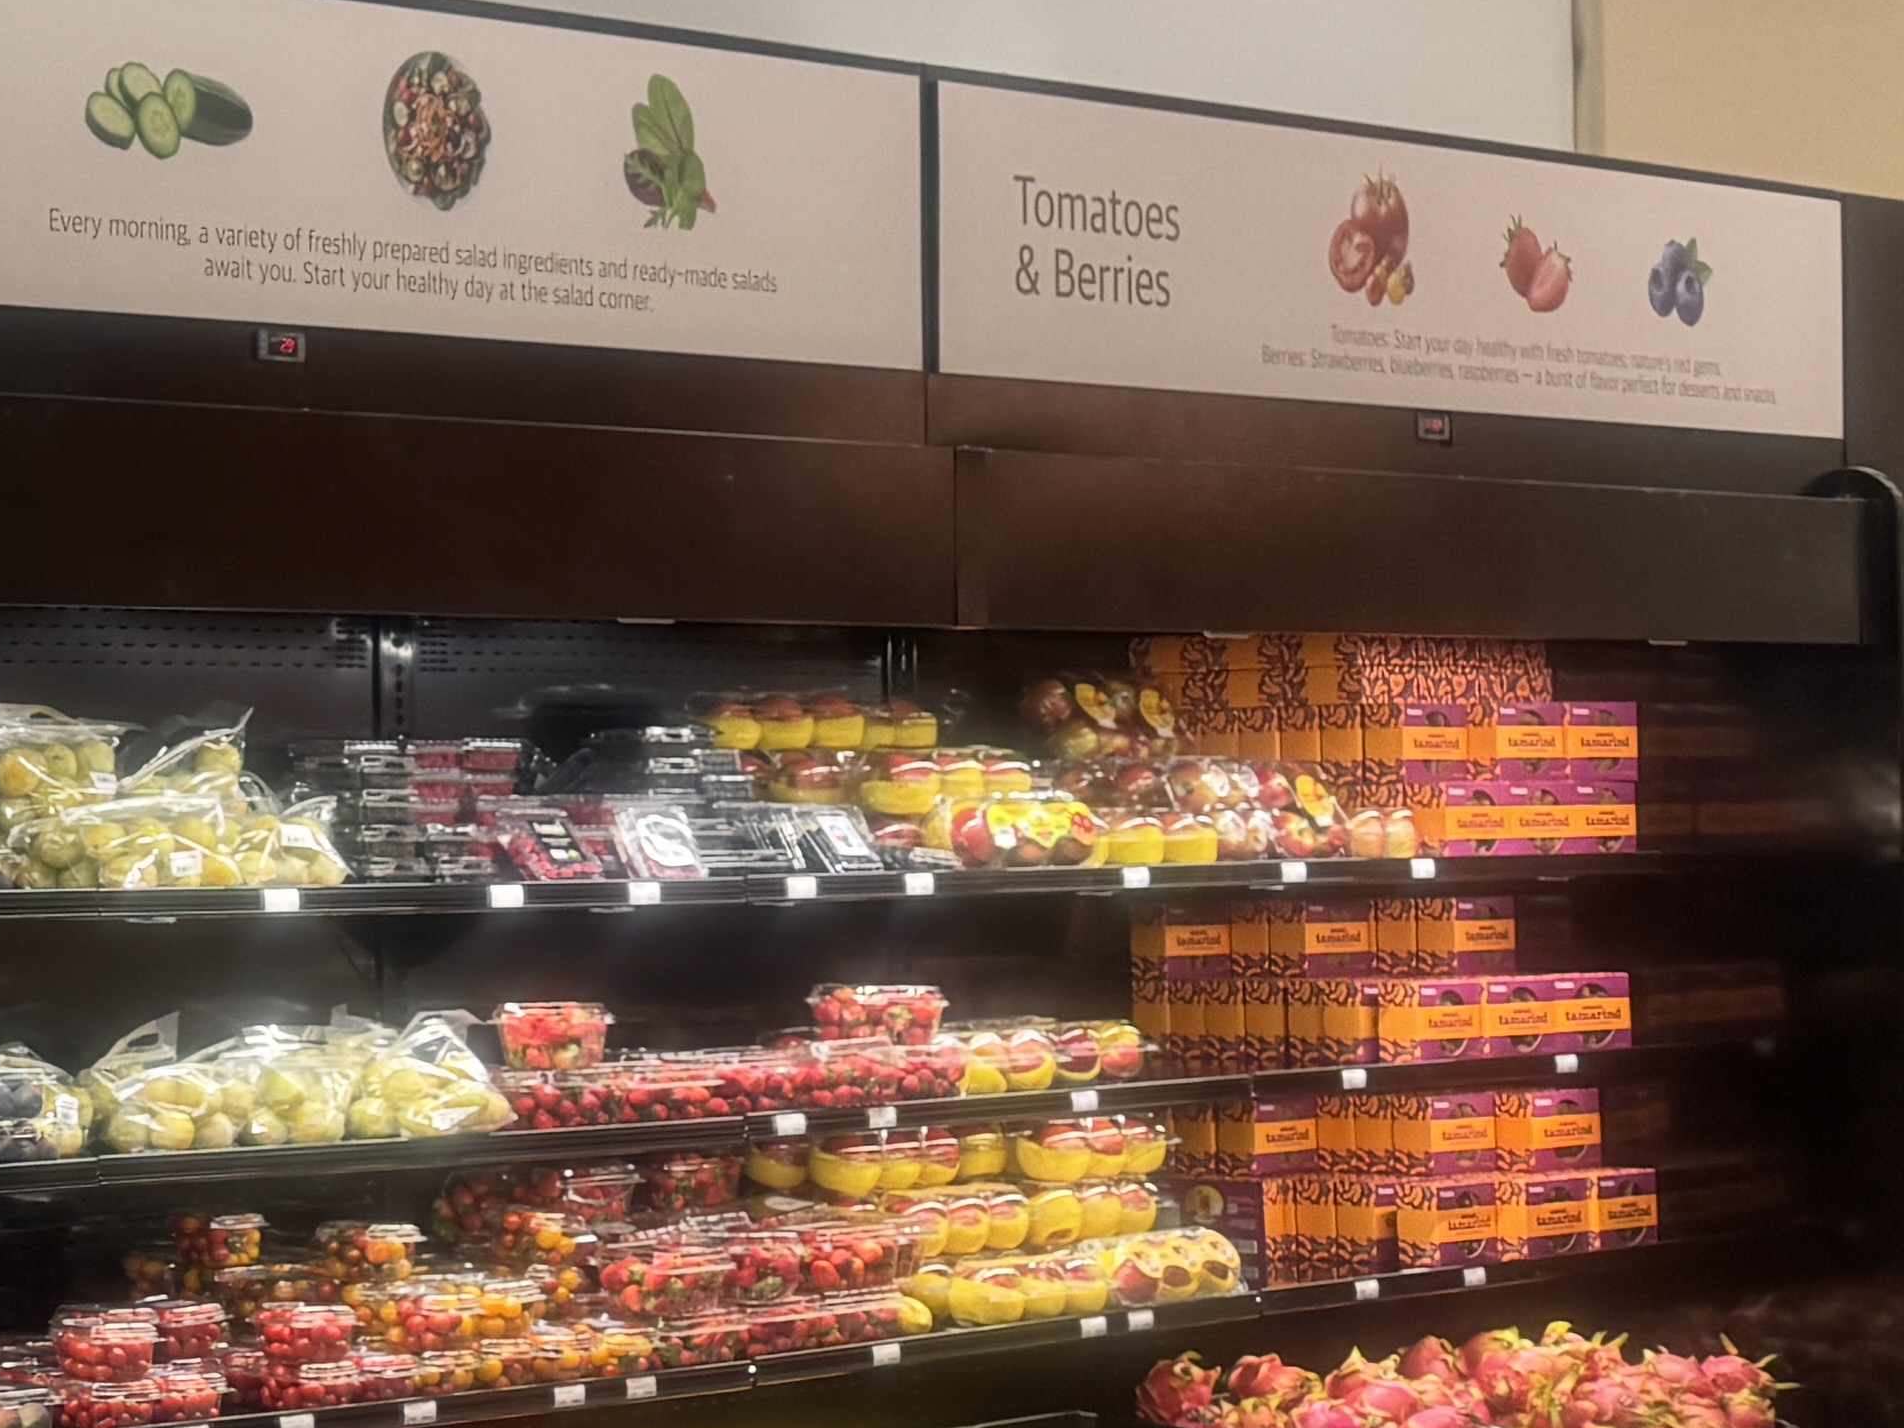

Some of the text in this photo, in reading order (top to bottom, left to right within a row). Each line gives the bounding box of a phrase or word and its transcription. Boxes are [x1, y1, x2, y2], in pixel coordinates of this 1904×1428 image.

[1013, 174, 1180, 242] Tomatoes
[49, 208, 777, 293] Every morning, a variety of freshly prepared salad ingredients and ready-made salads
[1015, 244, 1171, 307] & Berries
[204, 258, 654, 312] await you. Start your healthy day at the salad corner.
